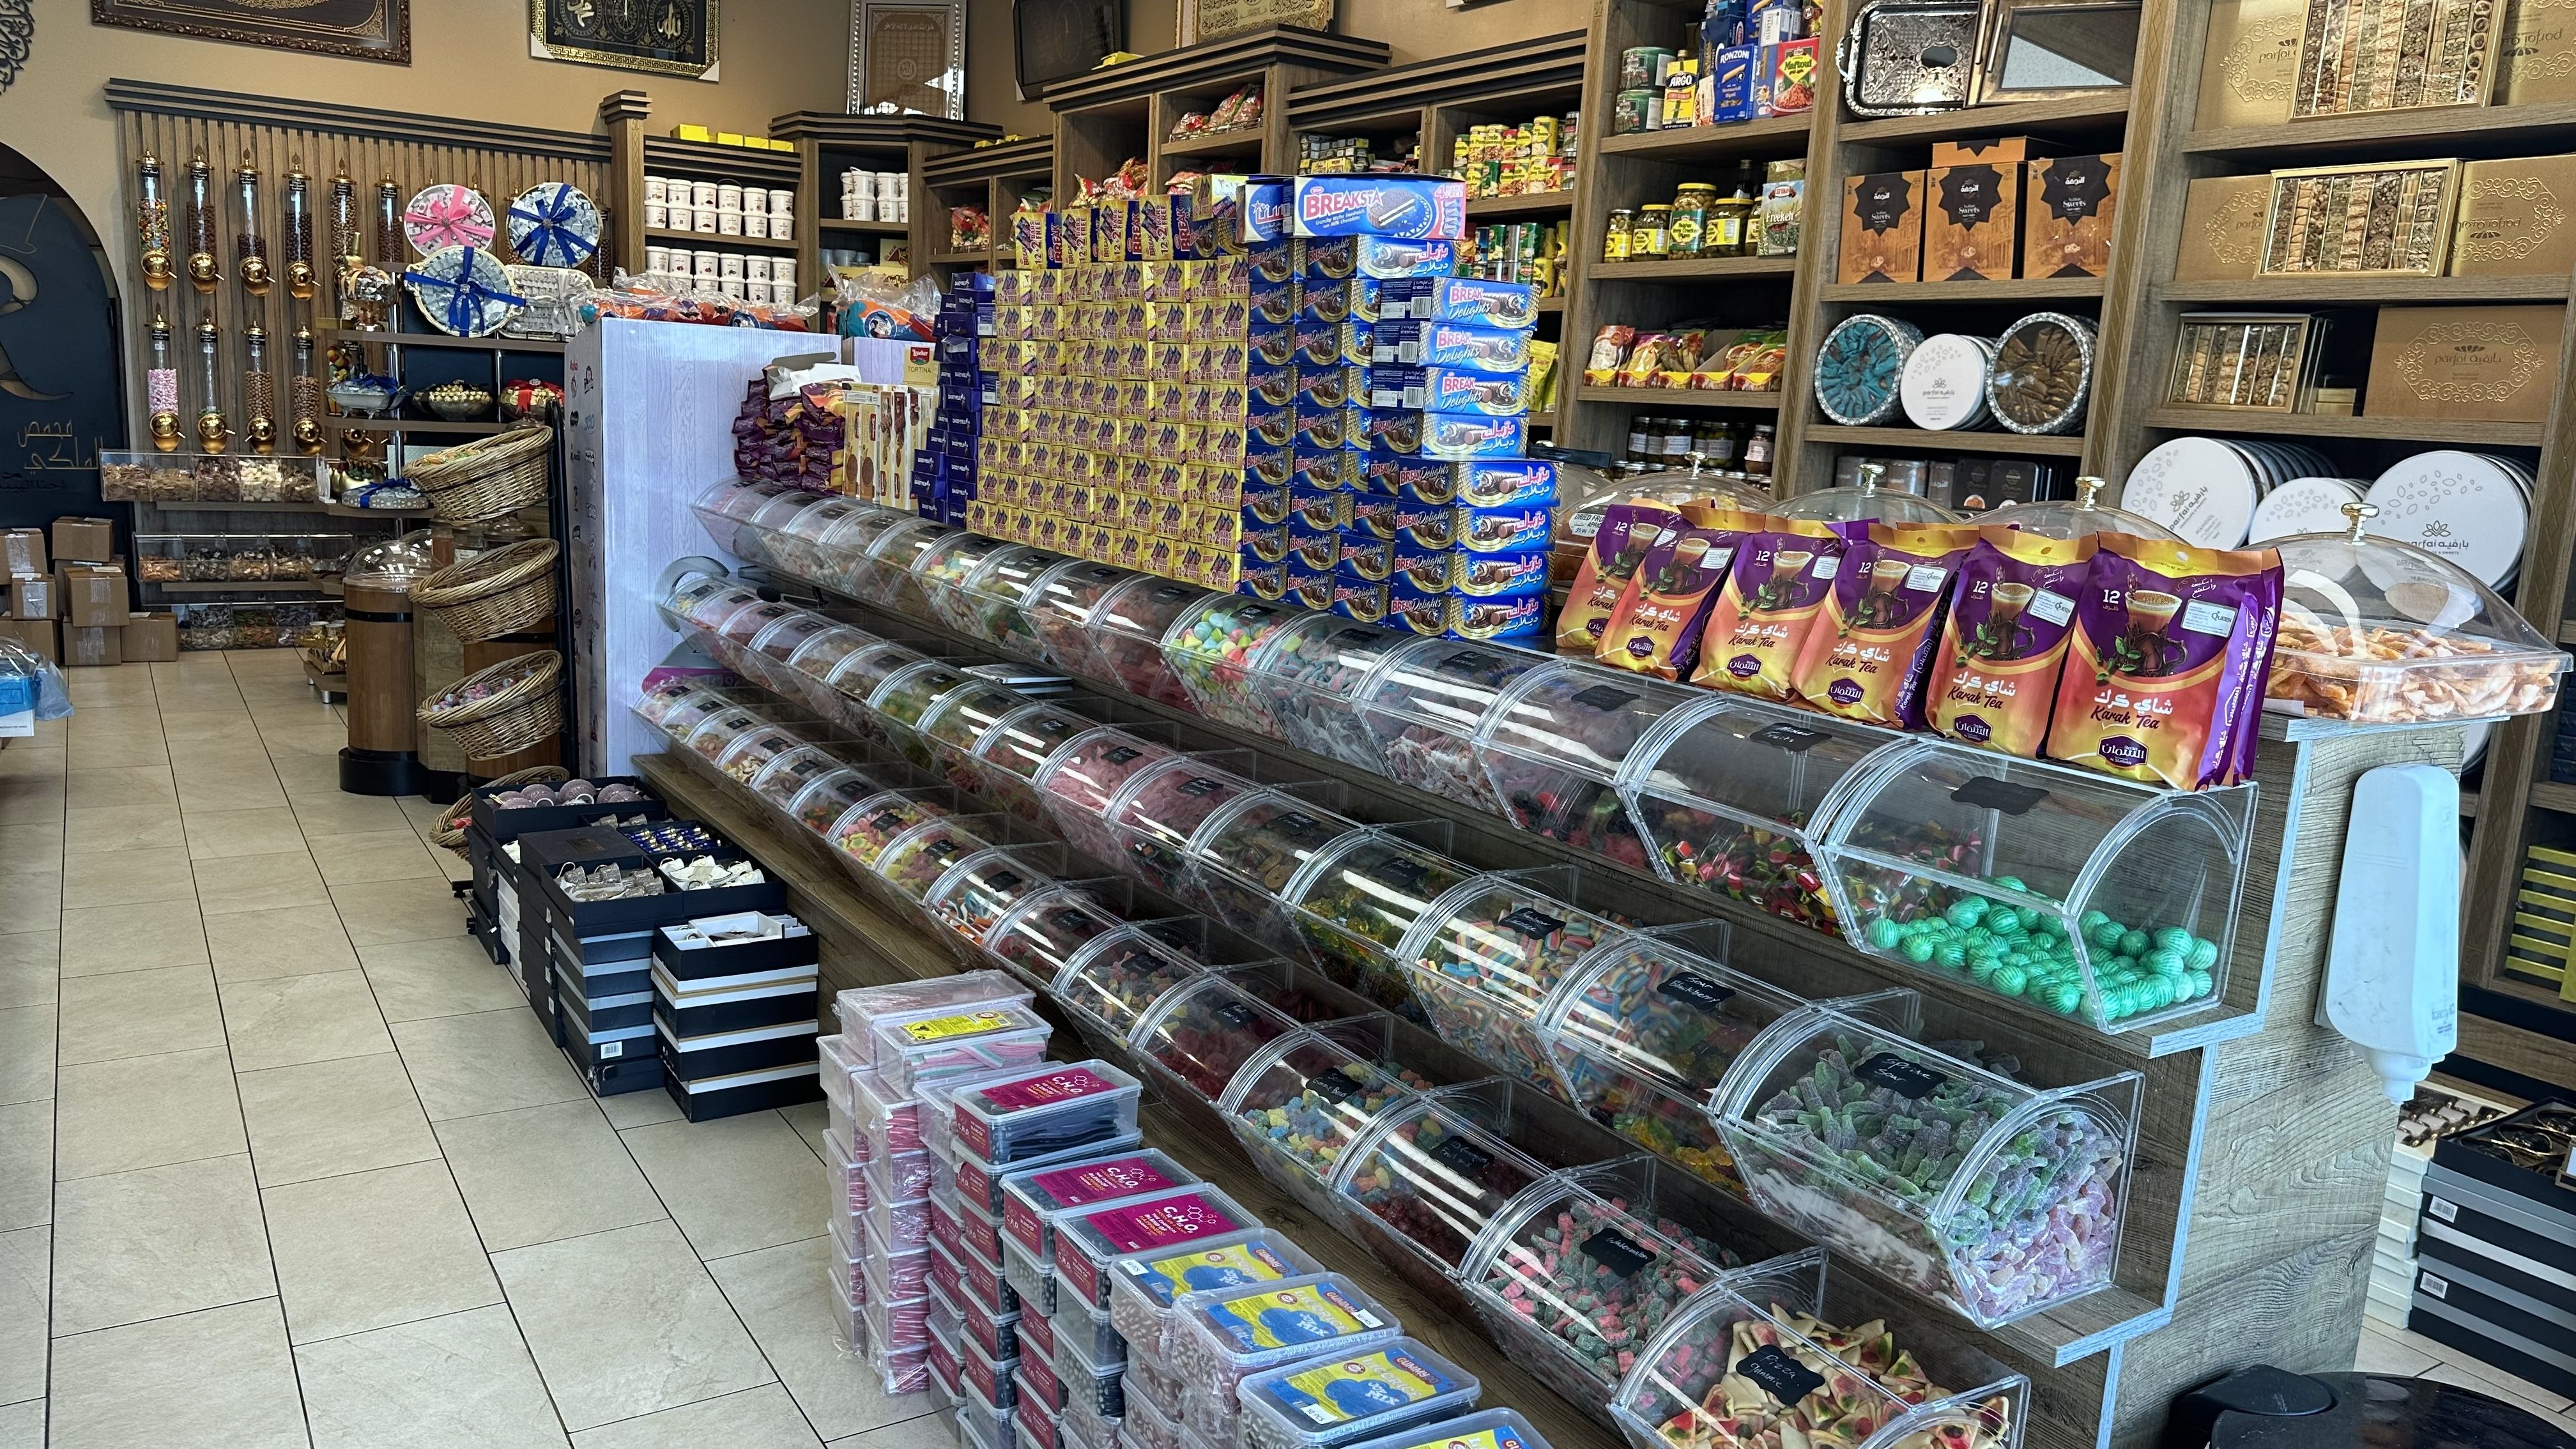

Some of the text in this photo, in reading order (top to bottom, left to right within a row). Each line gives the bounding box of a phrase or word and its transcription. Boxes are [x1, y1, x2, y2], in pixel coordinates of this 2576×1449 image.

[1720, 50, 1750, 63] RONZONI
[1784, 59, 1813, 70] Maftoul
[1669, 73, 1692, 87] ARGO
[1434, 185, 1445, 199] 4
[1305, 187, 1383, 220] BREAKSTA
[1958, 206, 1980, 215] Sweets
[2062, 199, 2086, 208] Sweets
[1766, 211, 1793, 223] Freekeh
[1156, 224, 1169, 255] 12+2
[1220, 279, 1235, 295] 12+2
[1449, 286, 1483, 303] BREAK
[1448, 301, 1492, 321] Delights
[1437, 331, 1472, 348] BREAK
[1435, 346, 1480, 364] Delights
[2434, 354, 2467, 365] parfai
[1442, 376, 1476, 394] BREAK
[1441, 390, 1483, 410] Delights
[1212, 406, 1229, 421] 12+2
[1209, 447, 1225, 462] 12+2
[1209, 489, 1224, 504] 12+2
[1617, 521, 1629, 532] 12
[1206, 531, 1220, 545] 12+2
[1755, 550, 1770, 562] 12
[1859, 562, 1872, 574] 12
[1202, 572, 1217, 586] 12+2
[1972, 580, 1989, 594] 12
[2103, 590, 2120, 604] 12
[1634, 604, 1681, 623] شاي كرك
[1629, 614, 1669, 632] Karak Tea
[1734, 623, 1788, 639] شاي كرك
[1728, 634, 1776, 649] Karak Tea
[1833, 640, 1891, 663] شاي كرك
[1825, 653, 1878, 674] Karak Tea
[1952, 671, 2016, 697] شاي كرك
[1947, 686, 2004, 710] Karak Tea
[2094, 689, 2173, 715] شاي كرك
[2090, 705, 2161, 730] Karak Tea
[1668, 979, 1721, 1002] Blackberry
[1882, 1058, 1932, 1080] Sprite
[1606, 1237, 1648, 1260] Watermelon
[1397, 1357, 1430, 1378] GUMMY
[1760, 1354, 1797, 1379] Pizza
[1365, 1390, 1400, 1406] MIX
